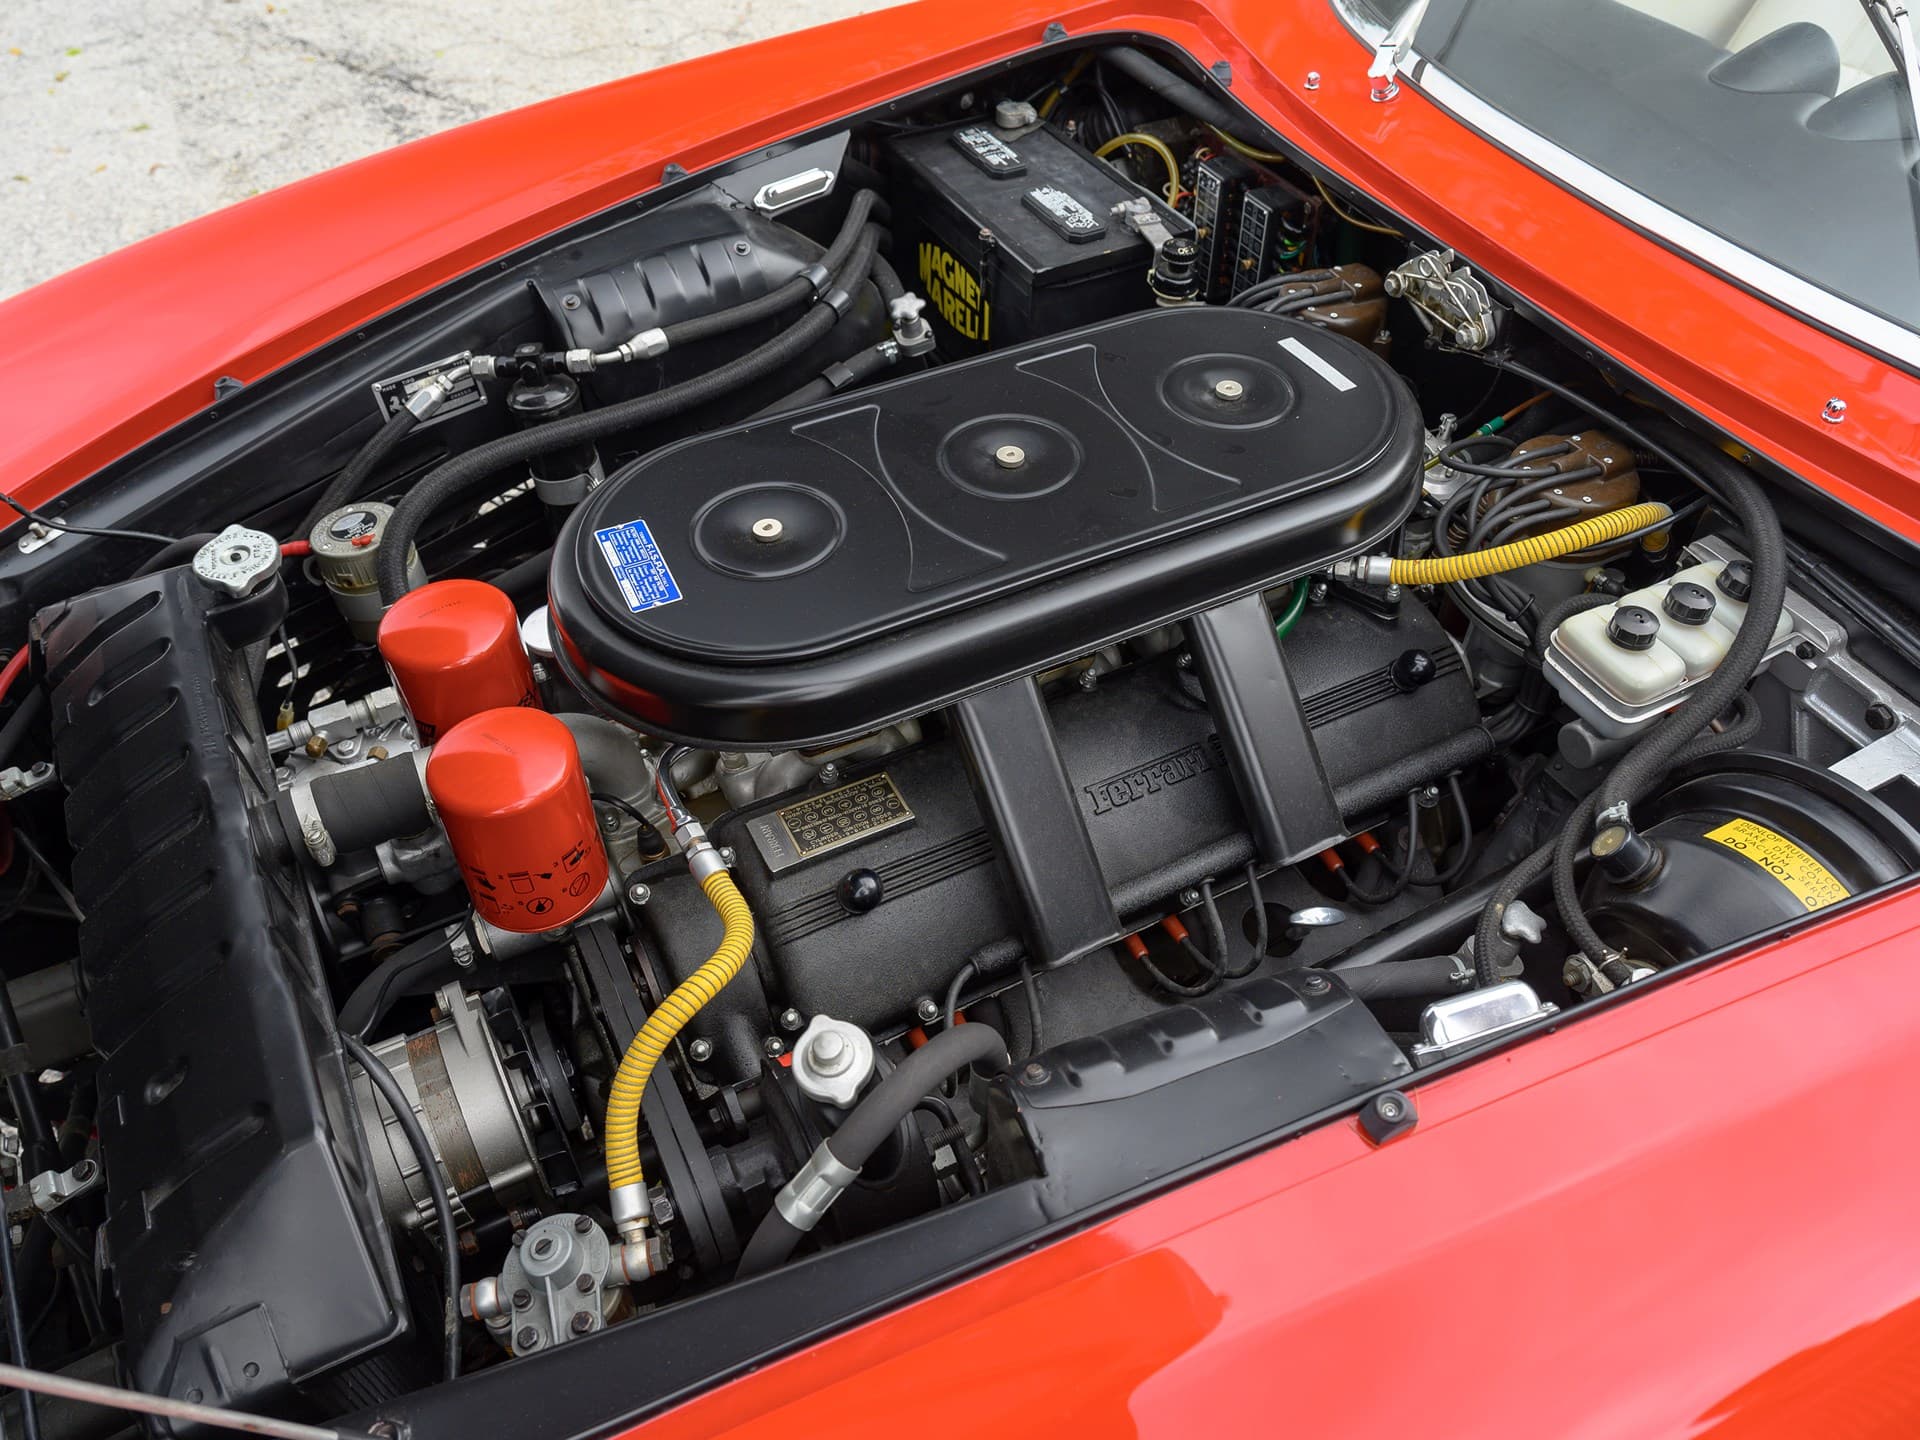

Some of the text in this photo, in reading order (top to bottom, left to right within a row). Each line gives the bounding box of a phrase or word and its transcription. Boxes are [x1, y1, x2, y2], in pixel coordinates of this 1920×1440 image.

[1084, 742, 1212, 816] Ferrari
[1732, 826, 1768, 844] BRAKE
[1740, 821, 1783, 843] DUNLOP
[1784, 843, 1823, 874] RUBBER
[1743, 837, 1790, 868] VACUUM
[1723, 837, 1748, 850] DO
[1759, 856, 1796, 882] NOT
